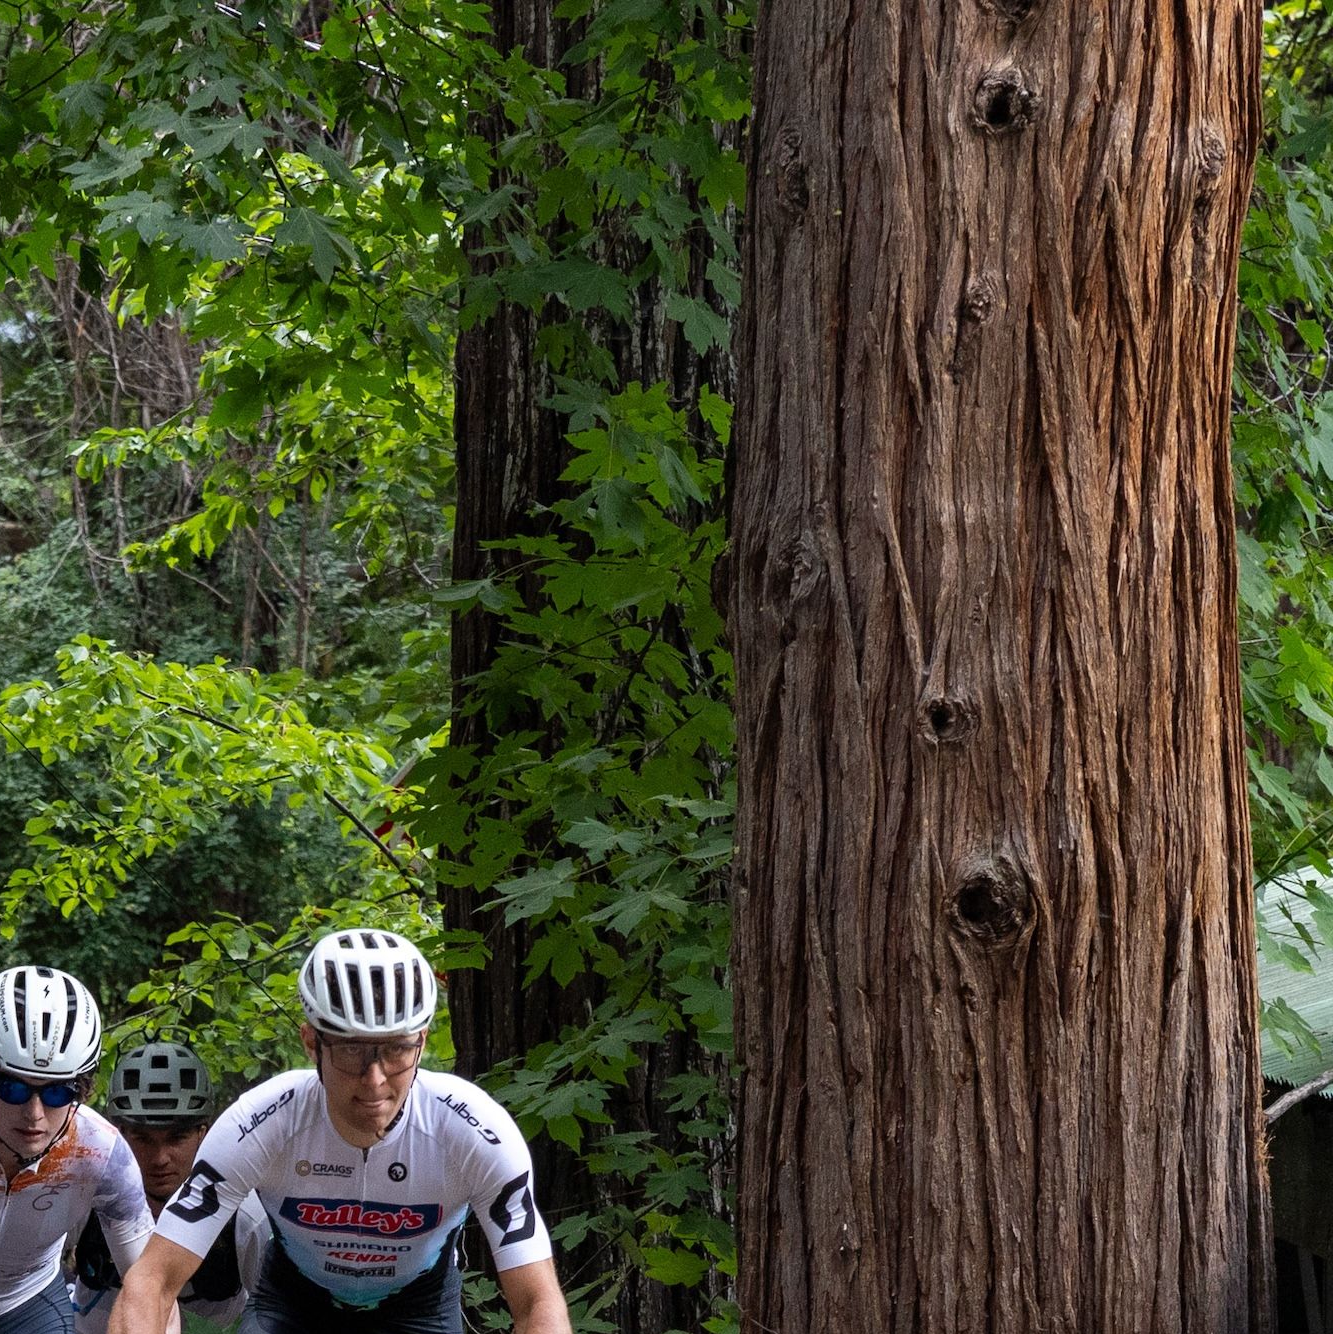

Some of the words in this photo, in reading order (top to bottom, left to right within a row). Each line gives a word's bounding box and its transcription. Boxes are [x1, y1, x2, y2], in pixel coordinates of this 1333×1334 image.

[313, 1163, 354, 1175] CRAIGS
[296, 1202, 425, 1234] Talley's
[312, 1239, 412, 1253] SHIMANO
[326, 1251, 398, 1264] KENDA
